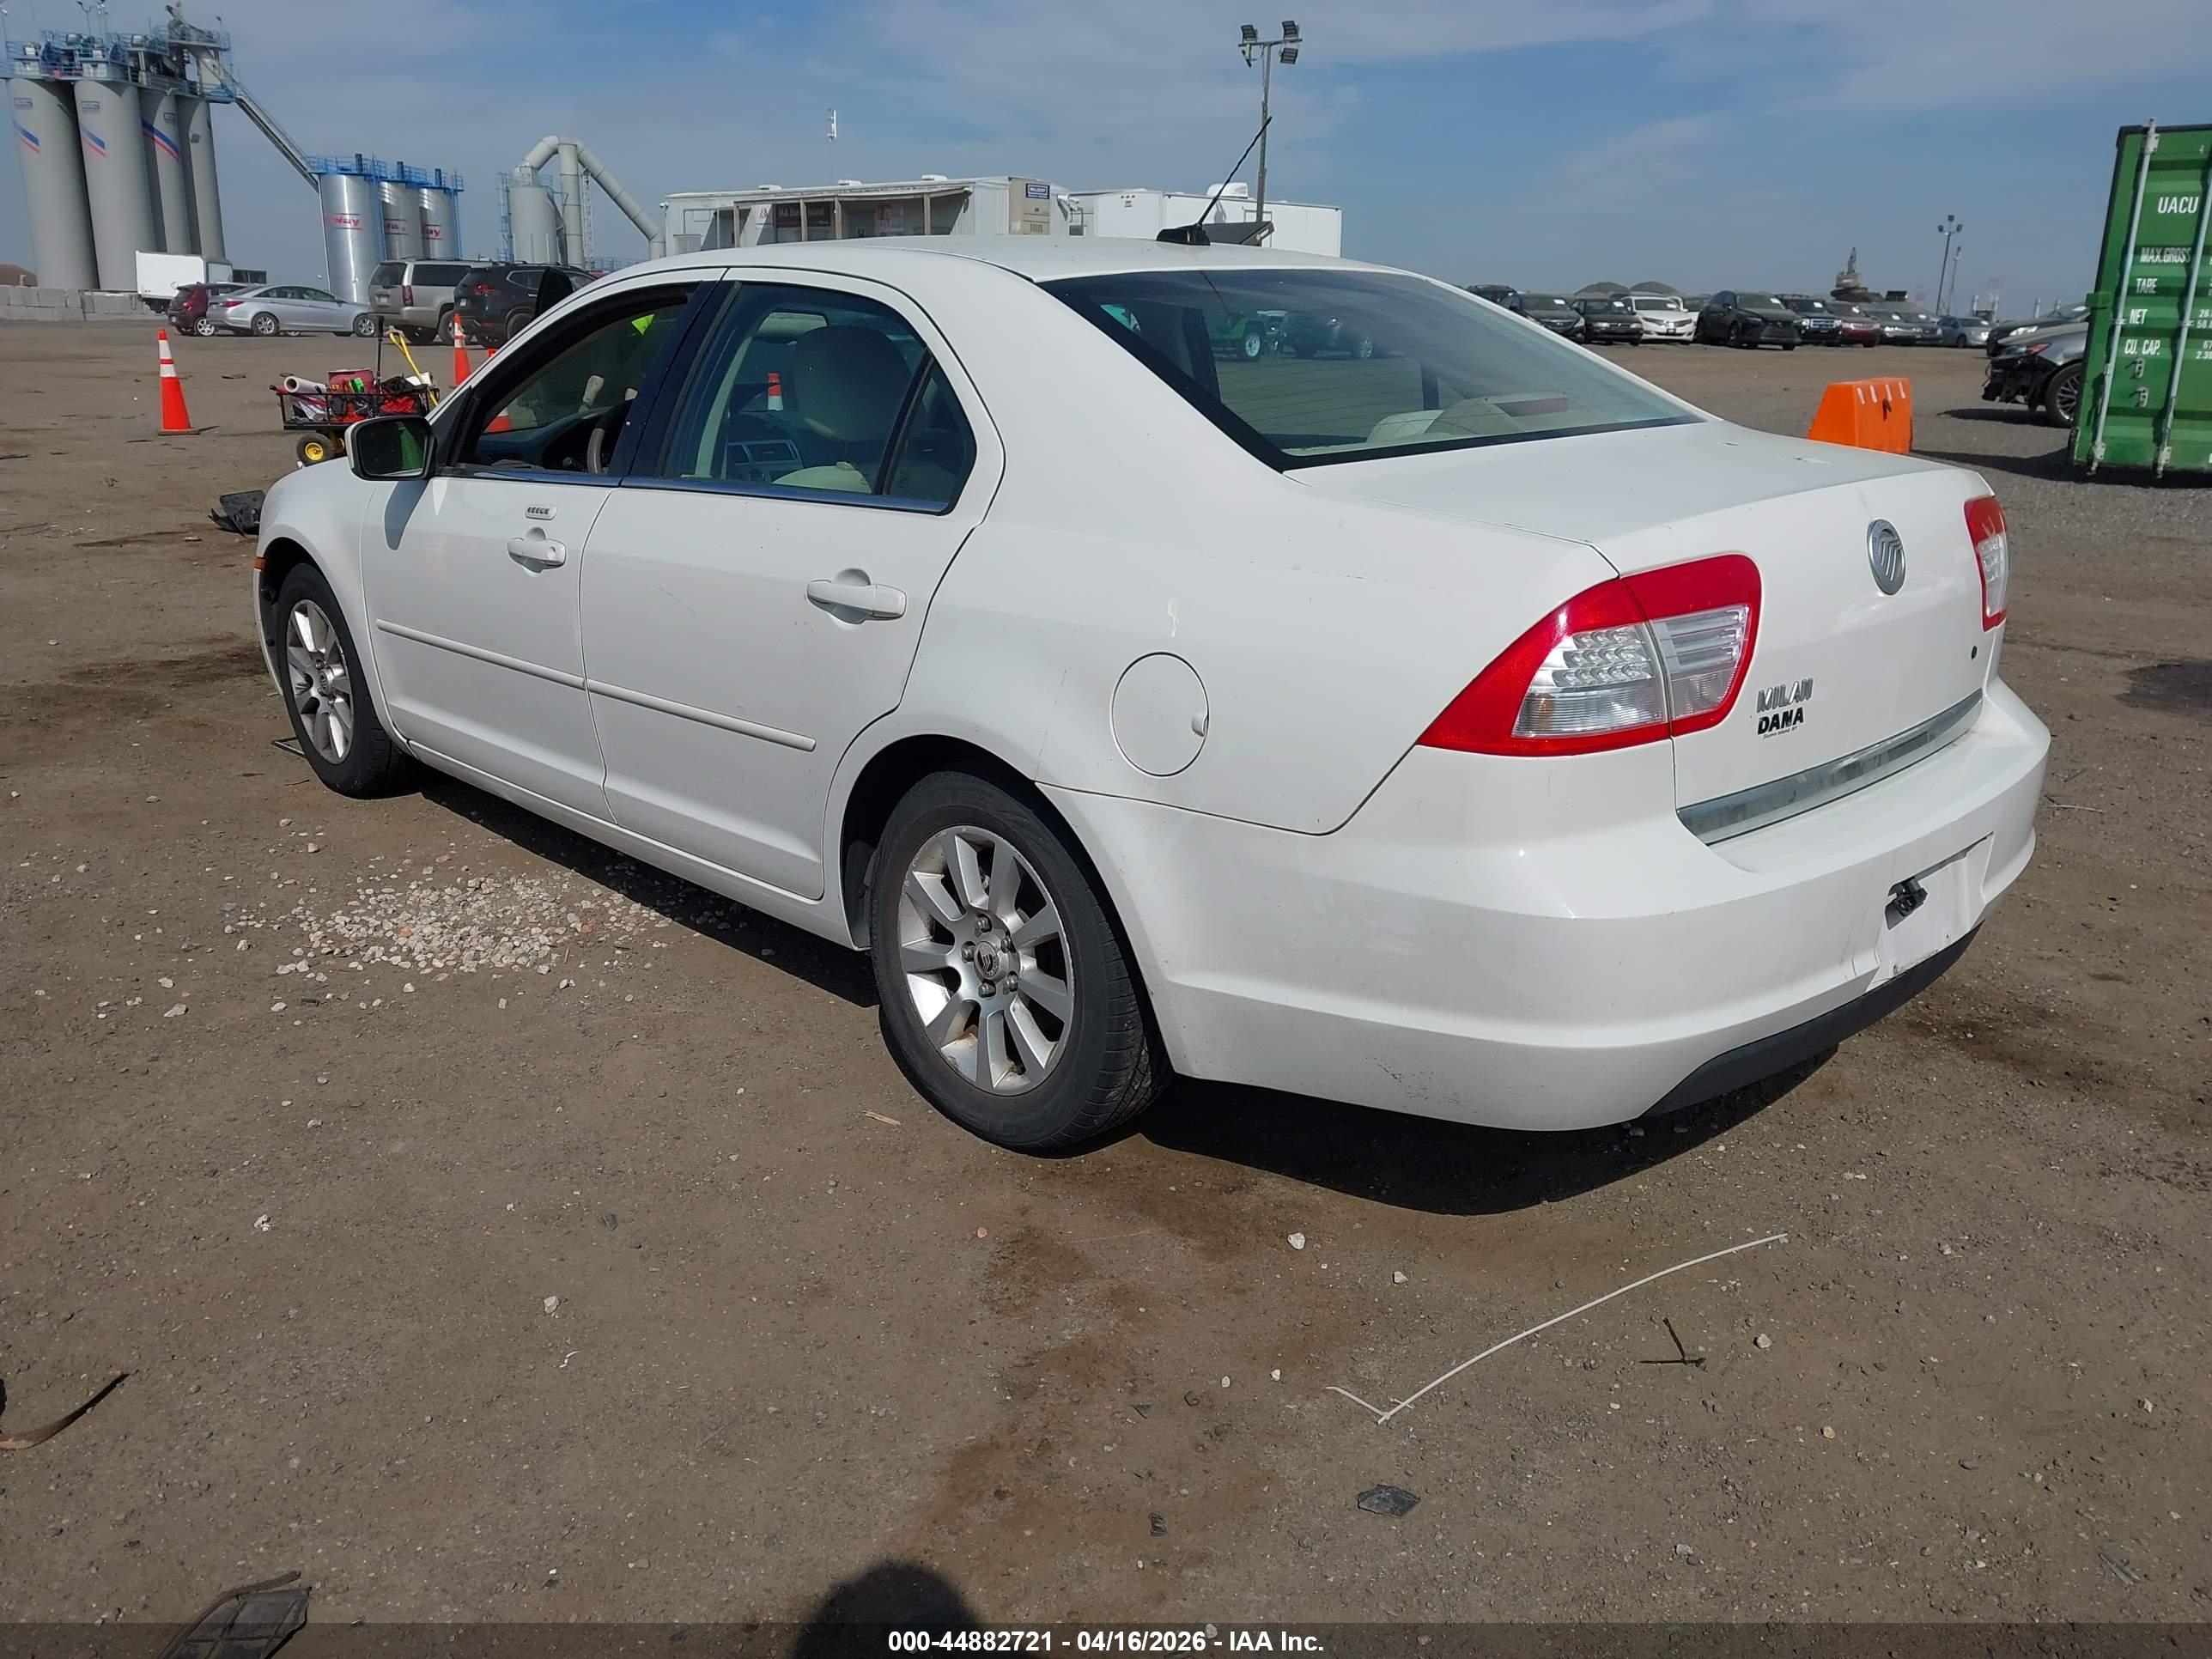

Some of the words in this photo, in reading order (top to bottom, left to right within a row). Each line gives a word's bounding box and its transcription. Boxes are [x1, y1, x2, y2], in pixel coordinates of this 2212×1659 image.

[2158, 196, 2199, 214] UACU
[2136, 277, 2158, 294] TARE
[2130, 308, 2148, 325] NET
[2124, 339, 2138, 355] CU.
[2142, 339, 2161, 356] CAP.
[1757, 678, 1814, 714] MILAN
[1758, 708, 1804, 735] DANA
